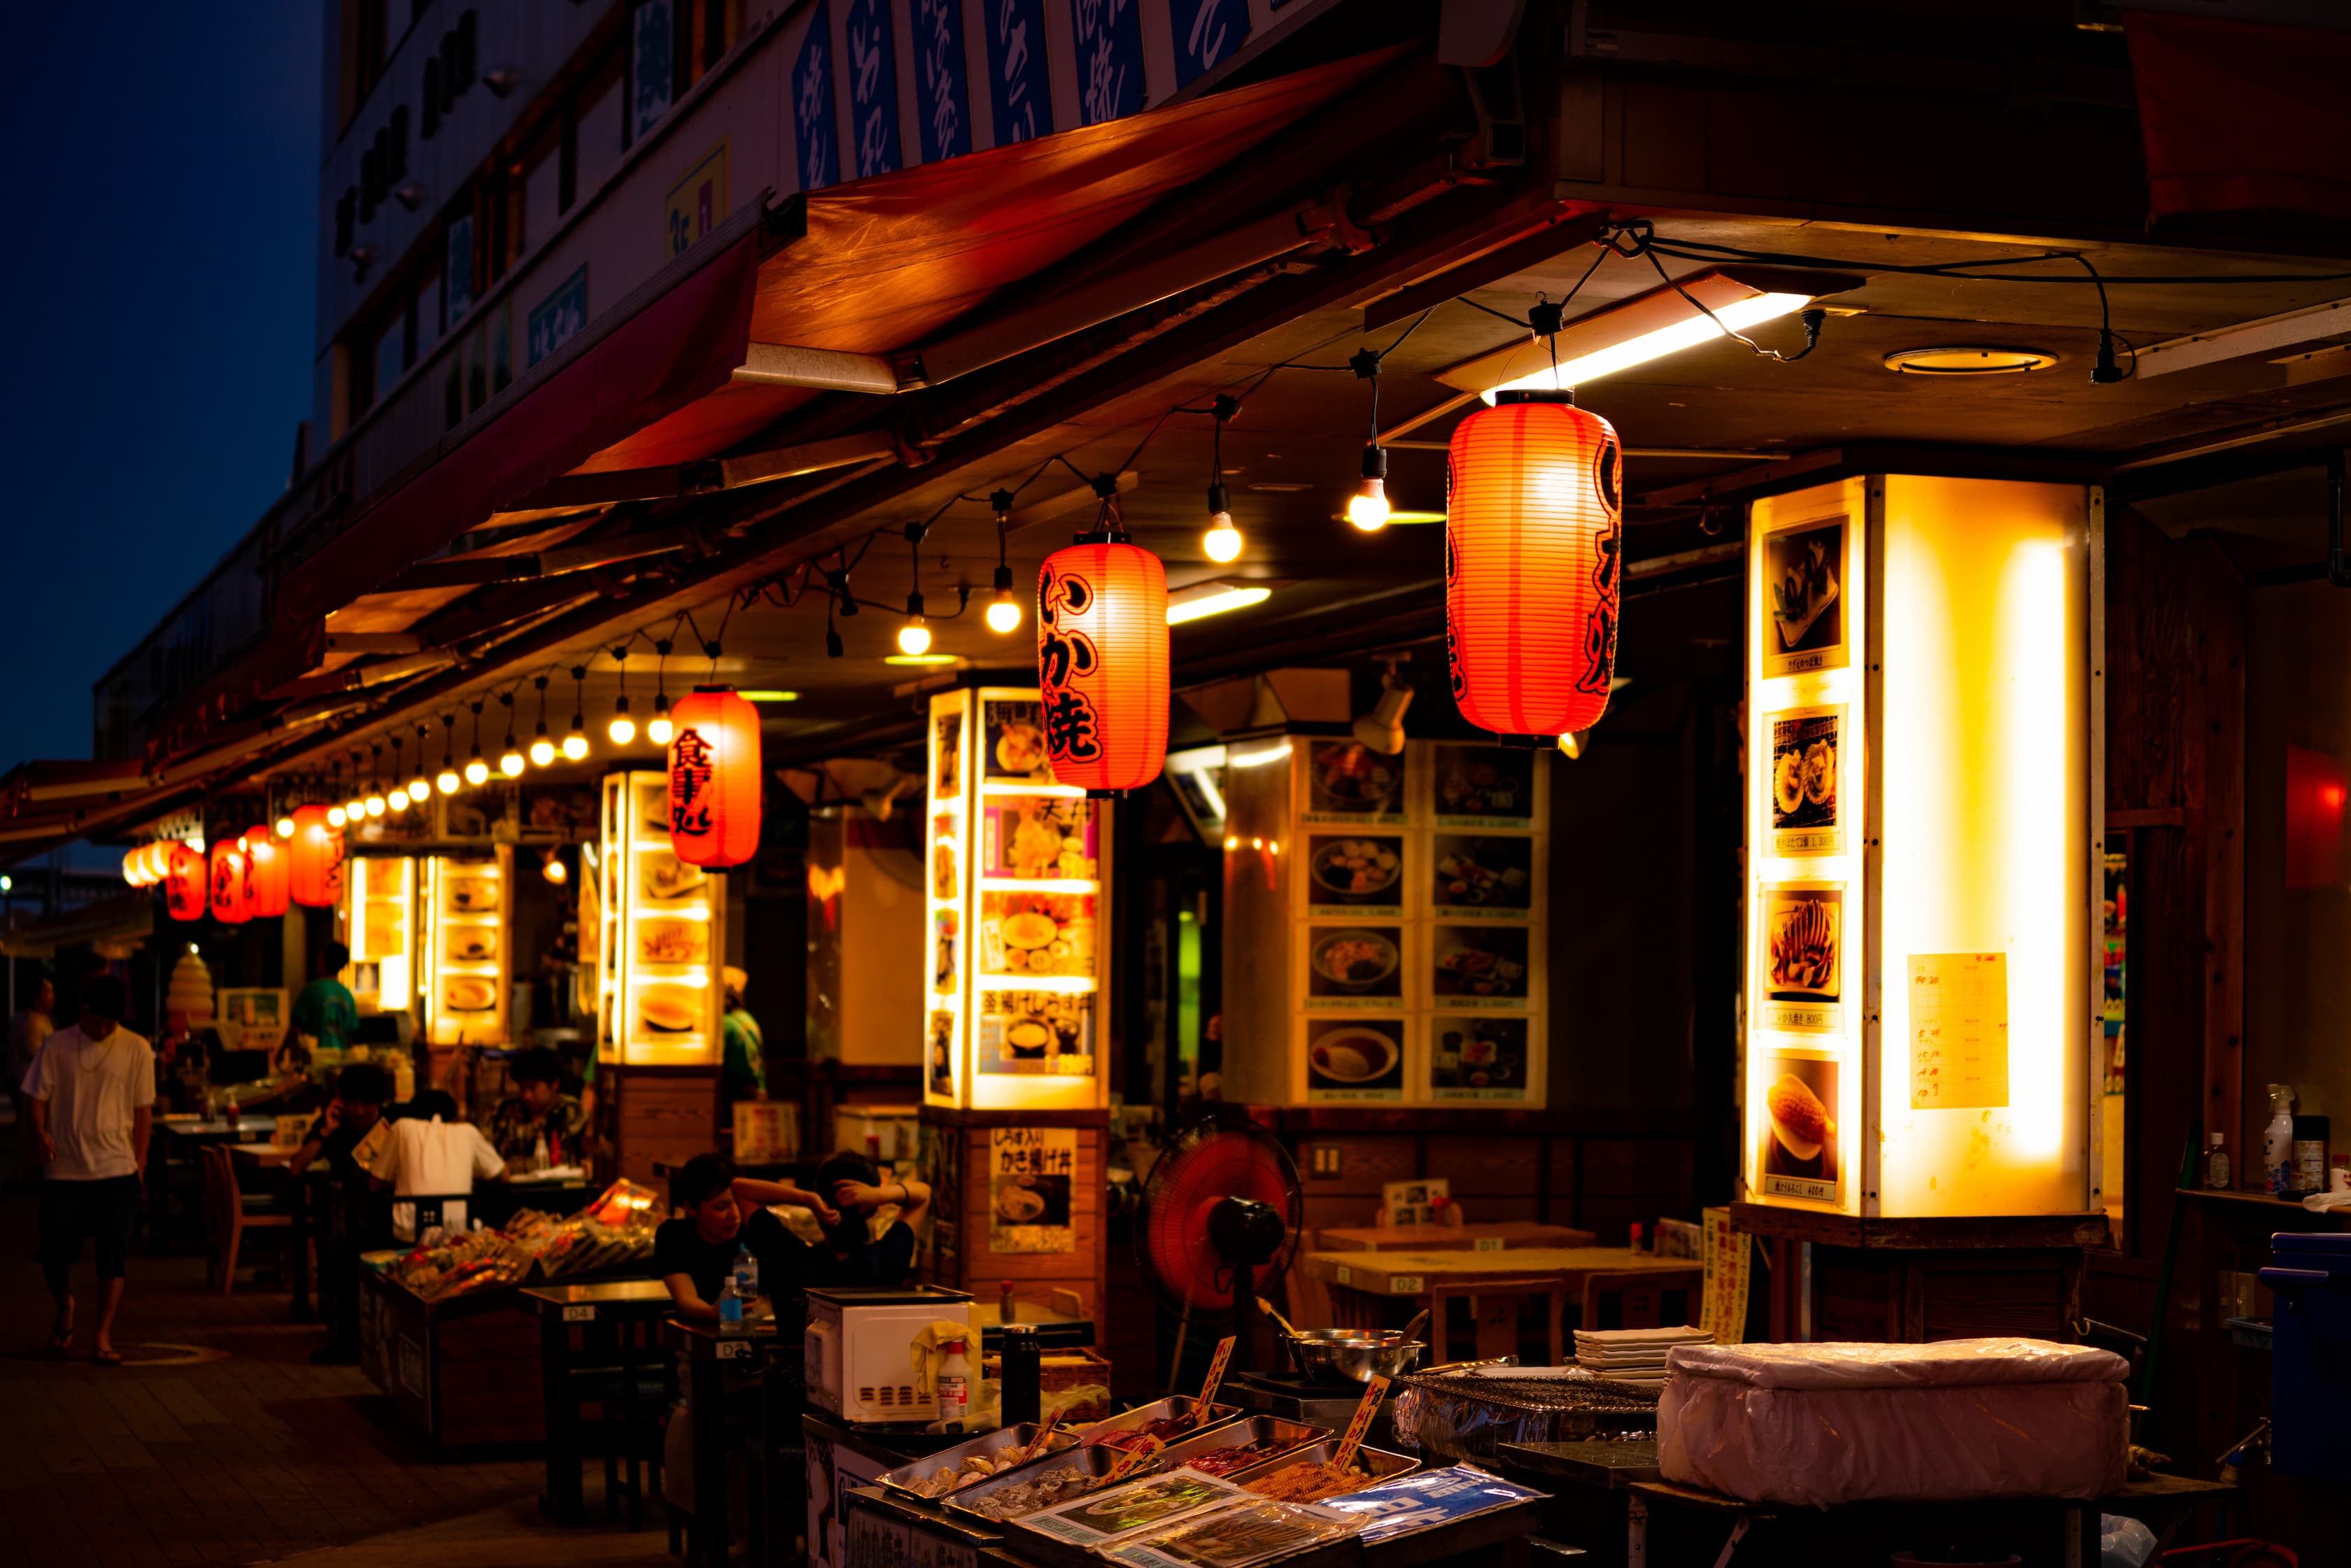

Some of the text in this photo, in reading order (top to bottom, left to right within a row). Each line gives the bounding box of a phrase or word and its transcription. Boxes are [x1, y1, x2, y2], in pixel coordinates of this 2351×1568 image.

[1040, 567, 1098, 758] いか焼
[672, 728, 712, 836] 食事処
[1001, 1149, 1072, 1173] かき揚げ丼
[1807, 1185, 1825, 1198] 400円
[1397, 1278, 1418, 1292] D2
[568, 1307, 588, 1321] D4
